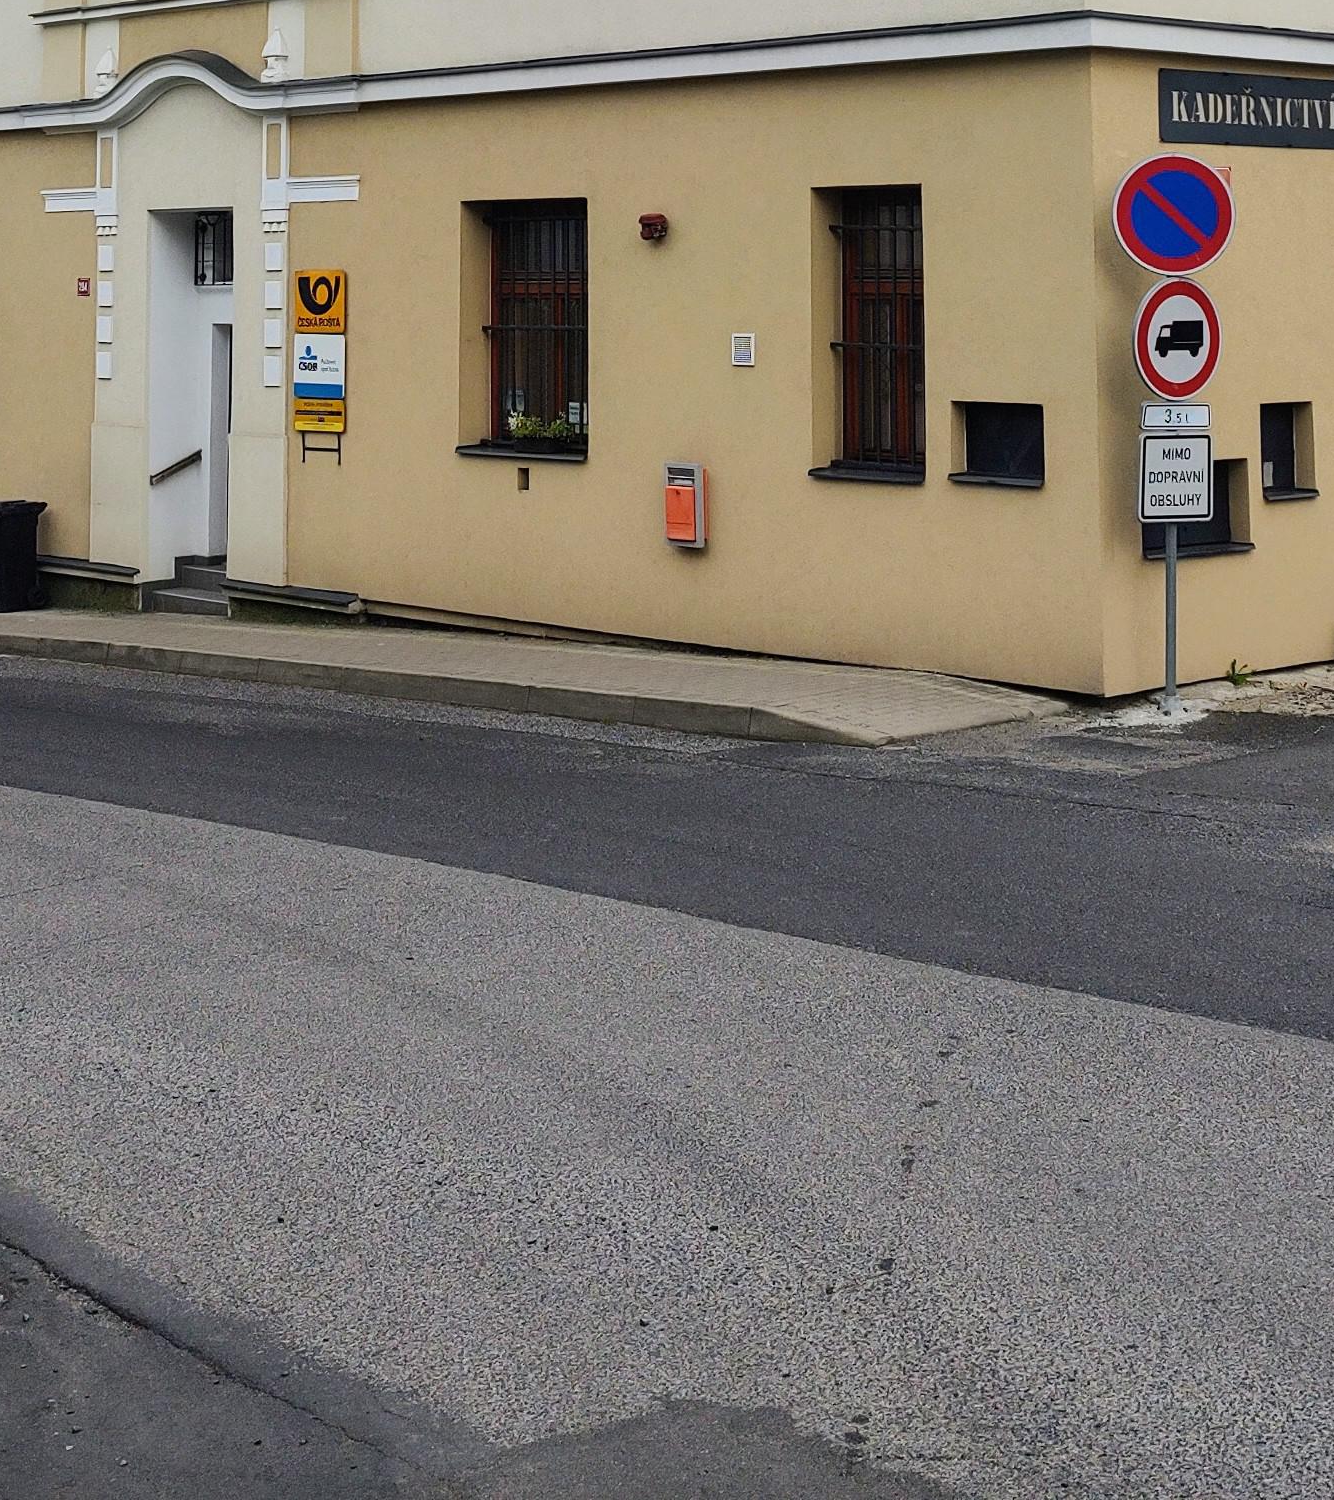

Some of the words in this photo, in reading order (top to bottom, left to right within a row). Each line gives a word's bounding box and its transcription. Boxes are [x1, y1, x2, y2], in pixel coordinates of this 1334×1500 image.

[1162, 447, 1191, 461] MIMO
[1148, 468, 1204, 484] DOPRAVNÍ
[1150, 494, 1202, 507] OBSLUHY
